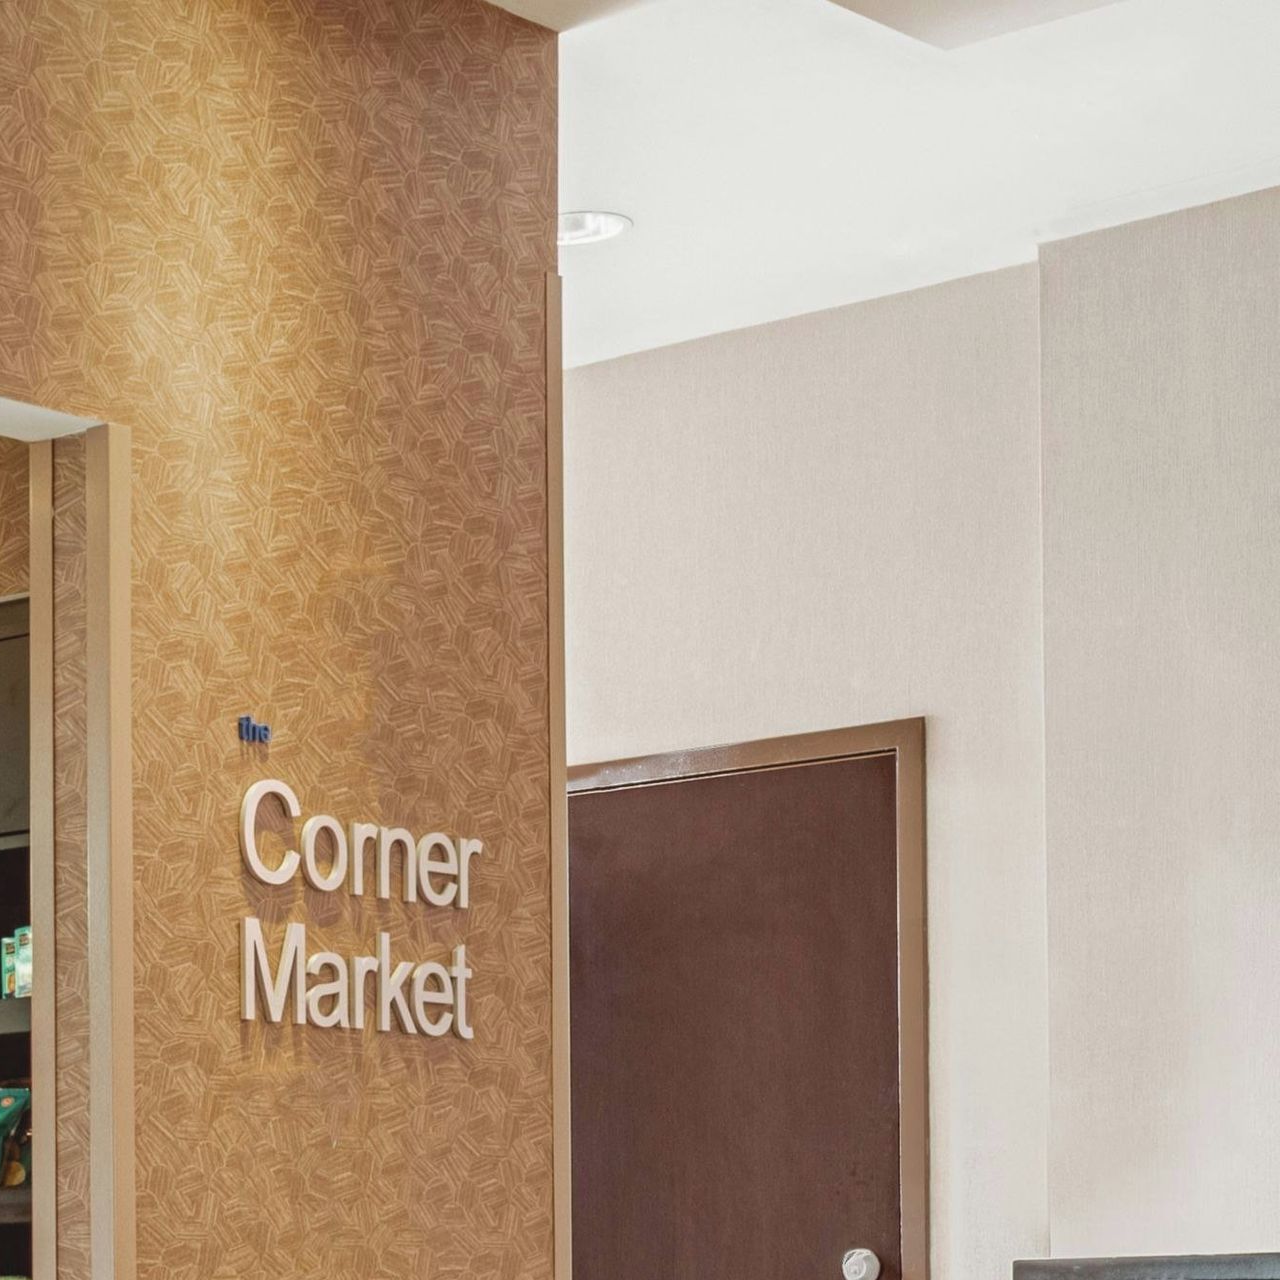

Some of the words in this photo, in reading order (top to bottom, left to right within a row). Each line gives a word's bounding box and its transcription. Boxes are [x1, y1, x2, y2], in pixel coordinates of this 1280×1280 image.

[238, 716, 271, 743] the
[240, 779, 483, 909] Corner
[240, 915, 474, 1040] Market
